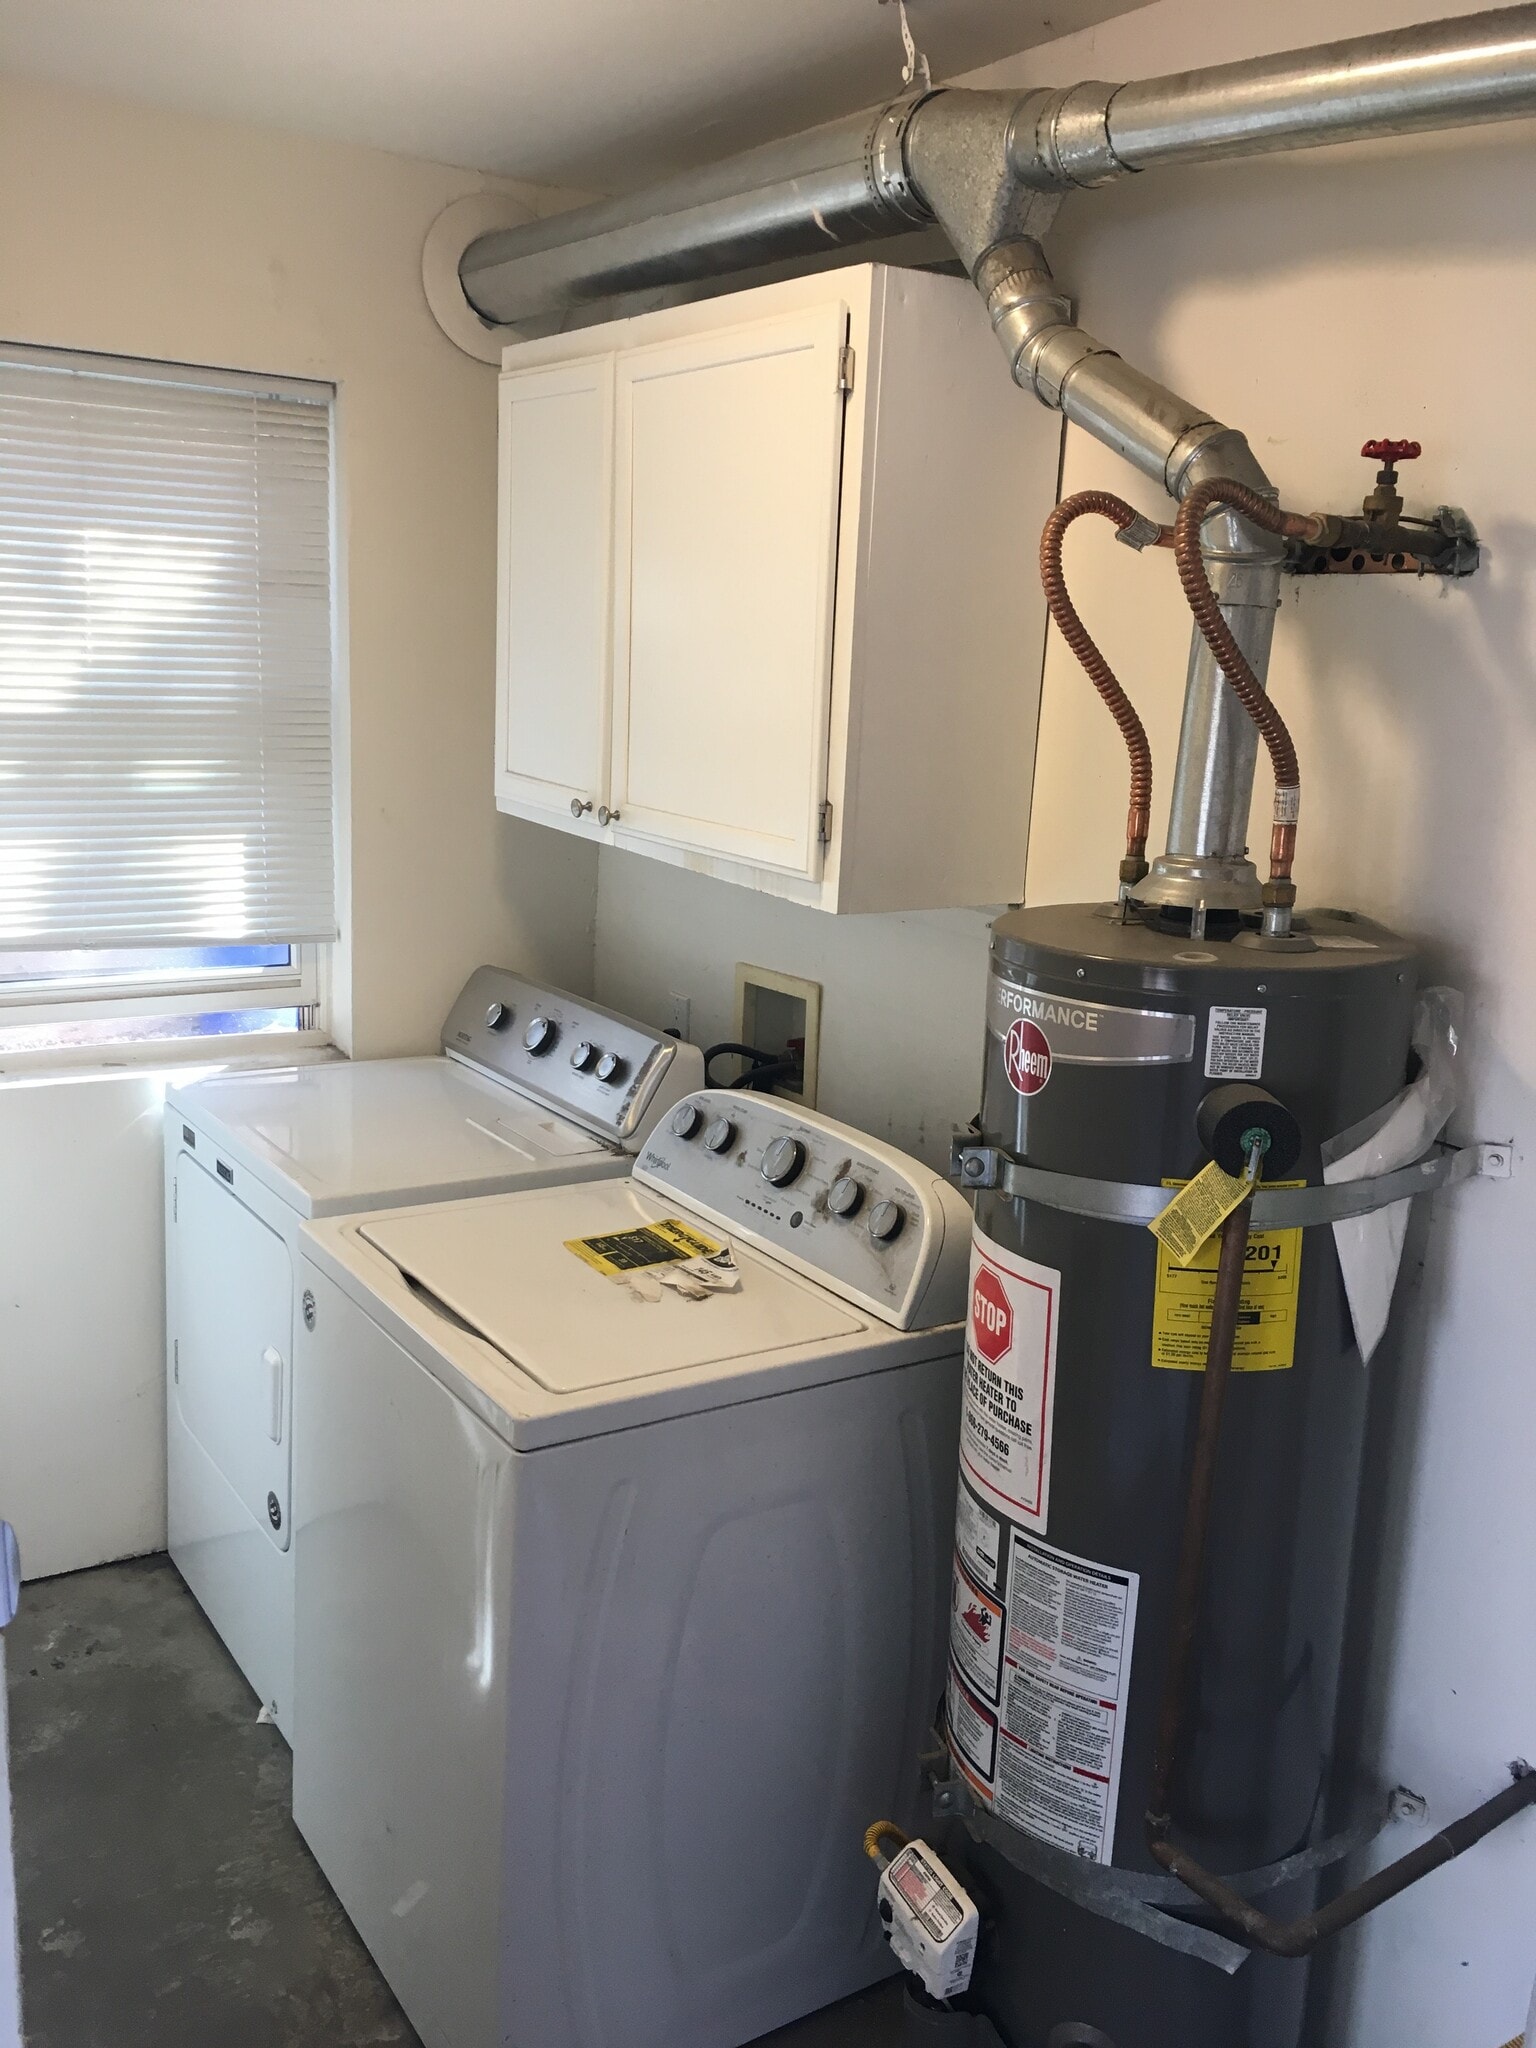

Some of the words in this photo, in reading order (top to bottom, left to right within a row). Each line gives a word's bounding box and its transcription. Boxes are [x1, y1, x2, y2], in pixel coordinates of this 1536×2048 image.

[1008, 1020, 1049, 1082] Rheem
[645, 1150, 672, 1171] Whirlpool
[974, 1289, 1007, 1336] STOP
[978, 1360, 1002, 1390] RETURN
[1004, 1379, 1024, 1401] THIS
[979, 1378, 1004, 1406] HEATER
[1005, 1396, 1017, 1413] TO
[988, 1400, 1032, 1437] PURCHASE
[1090, 1578, 1109, 1590] HEATER
